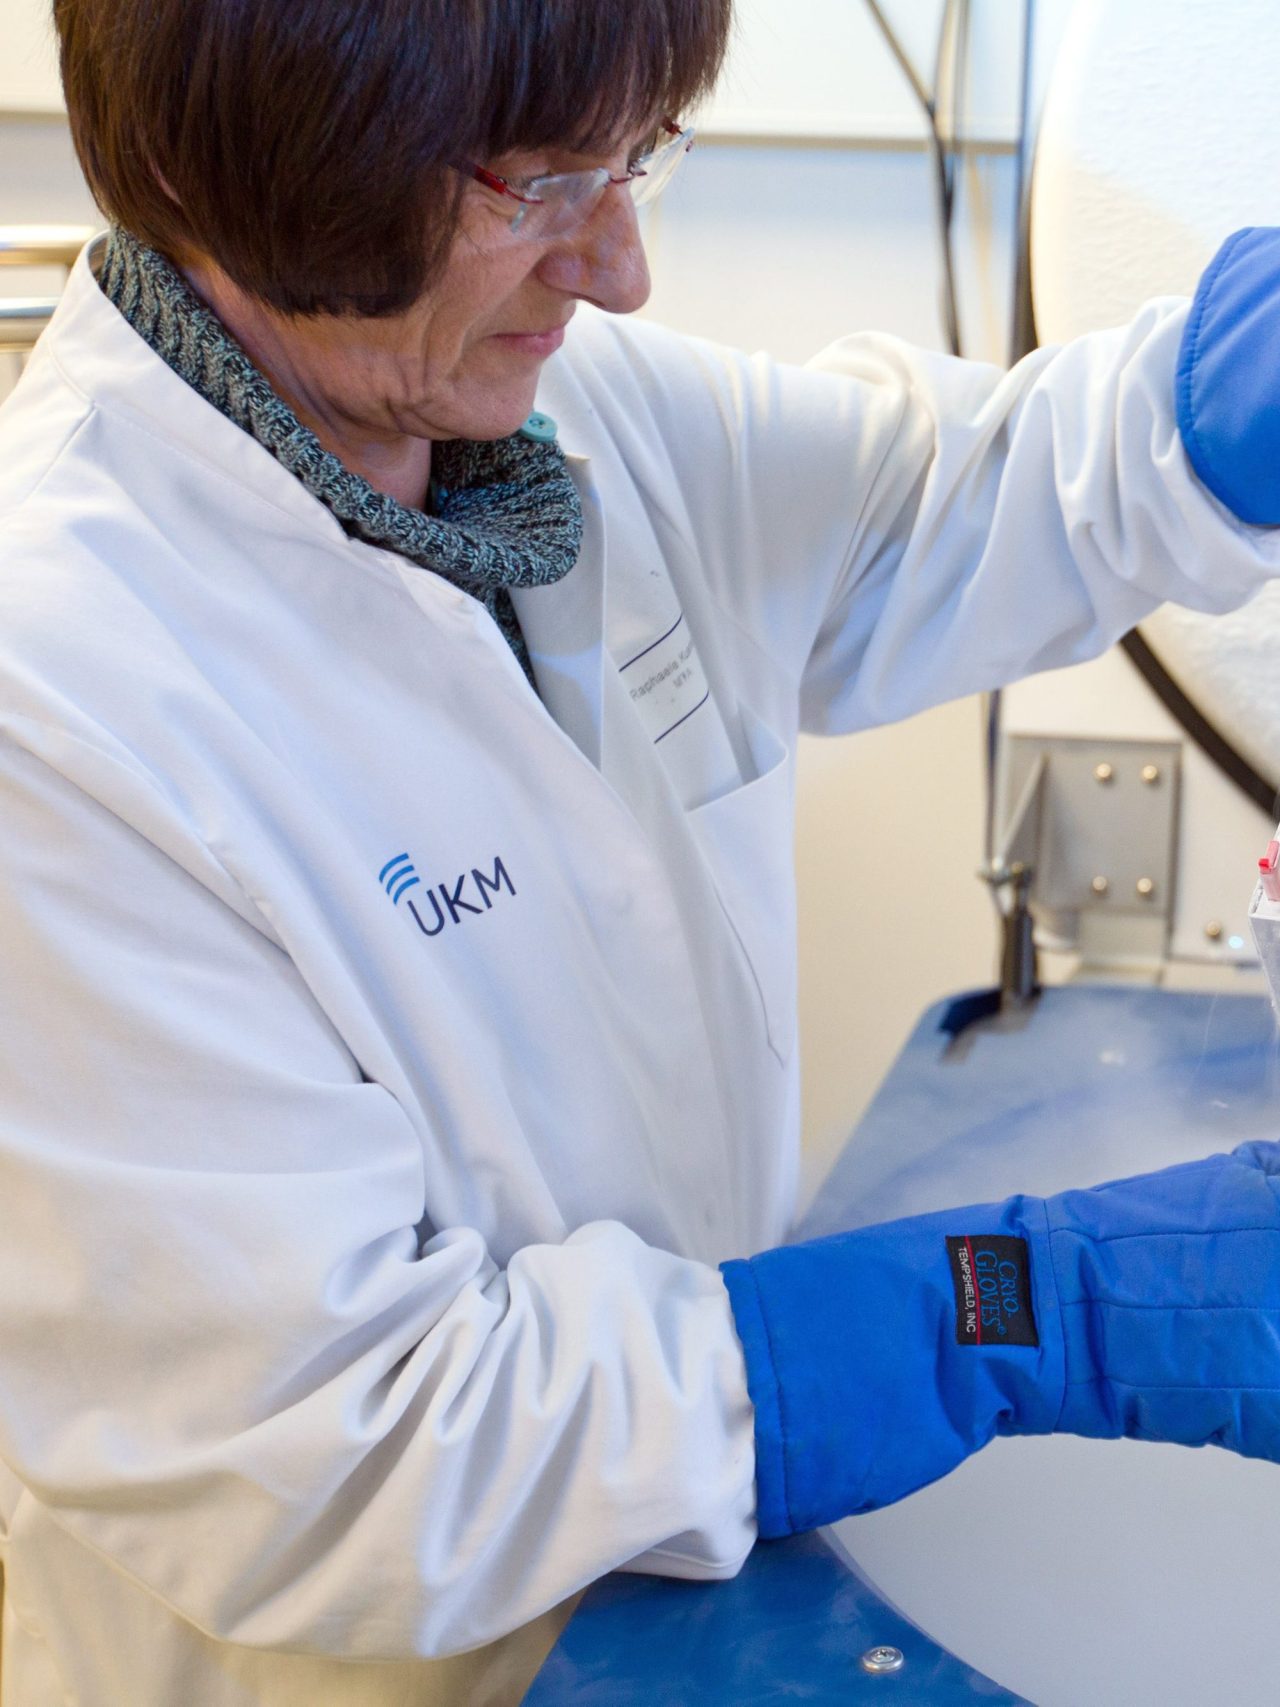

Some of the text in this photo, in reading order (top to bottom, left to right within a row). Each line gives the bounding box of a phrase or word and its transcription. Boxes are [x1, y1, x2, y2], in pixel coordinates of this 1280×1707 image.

[407, 856, 517, 936] UKM
[958, 1247, 976, 1333] TEMPSHIELD, INC
